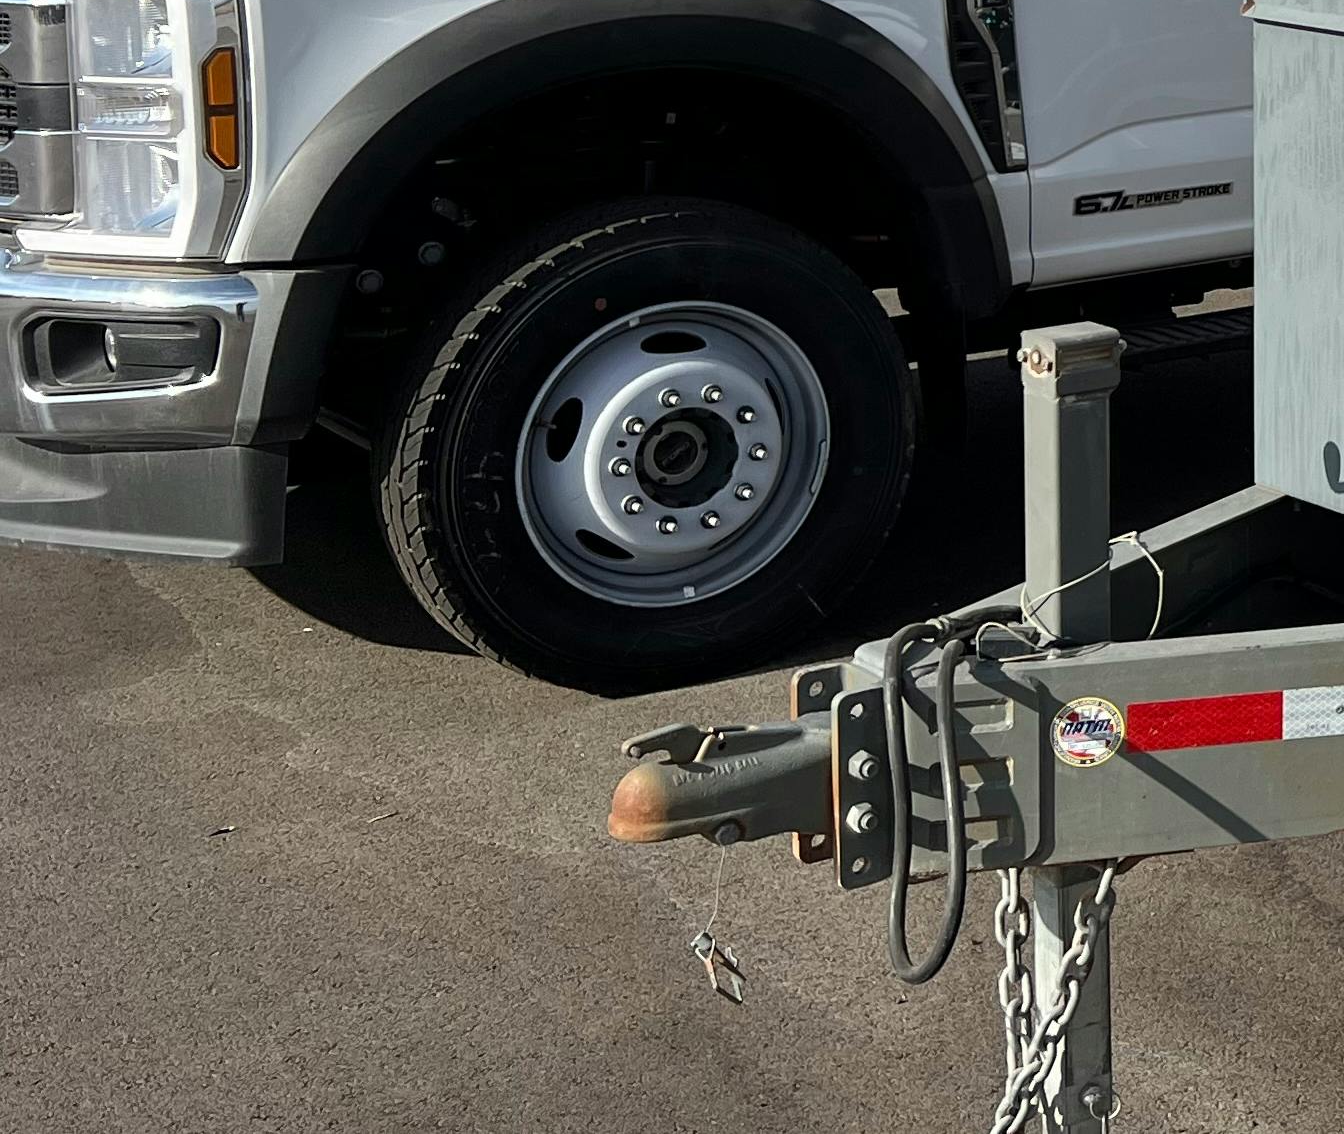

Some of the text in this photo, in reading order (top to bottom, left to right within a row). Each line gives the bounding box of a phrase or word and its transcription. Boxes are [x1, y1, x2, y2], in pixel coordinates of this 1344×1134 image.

[1074, 183, 1231, 216] 6.7L POWER STROKE
